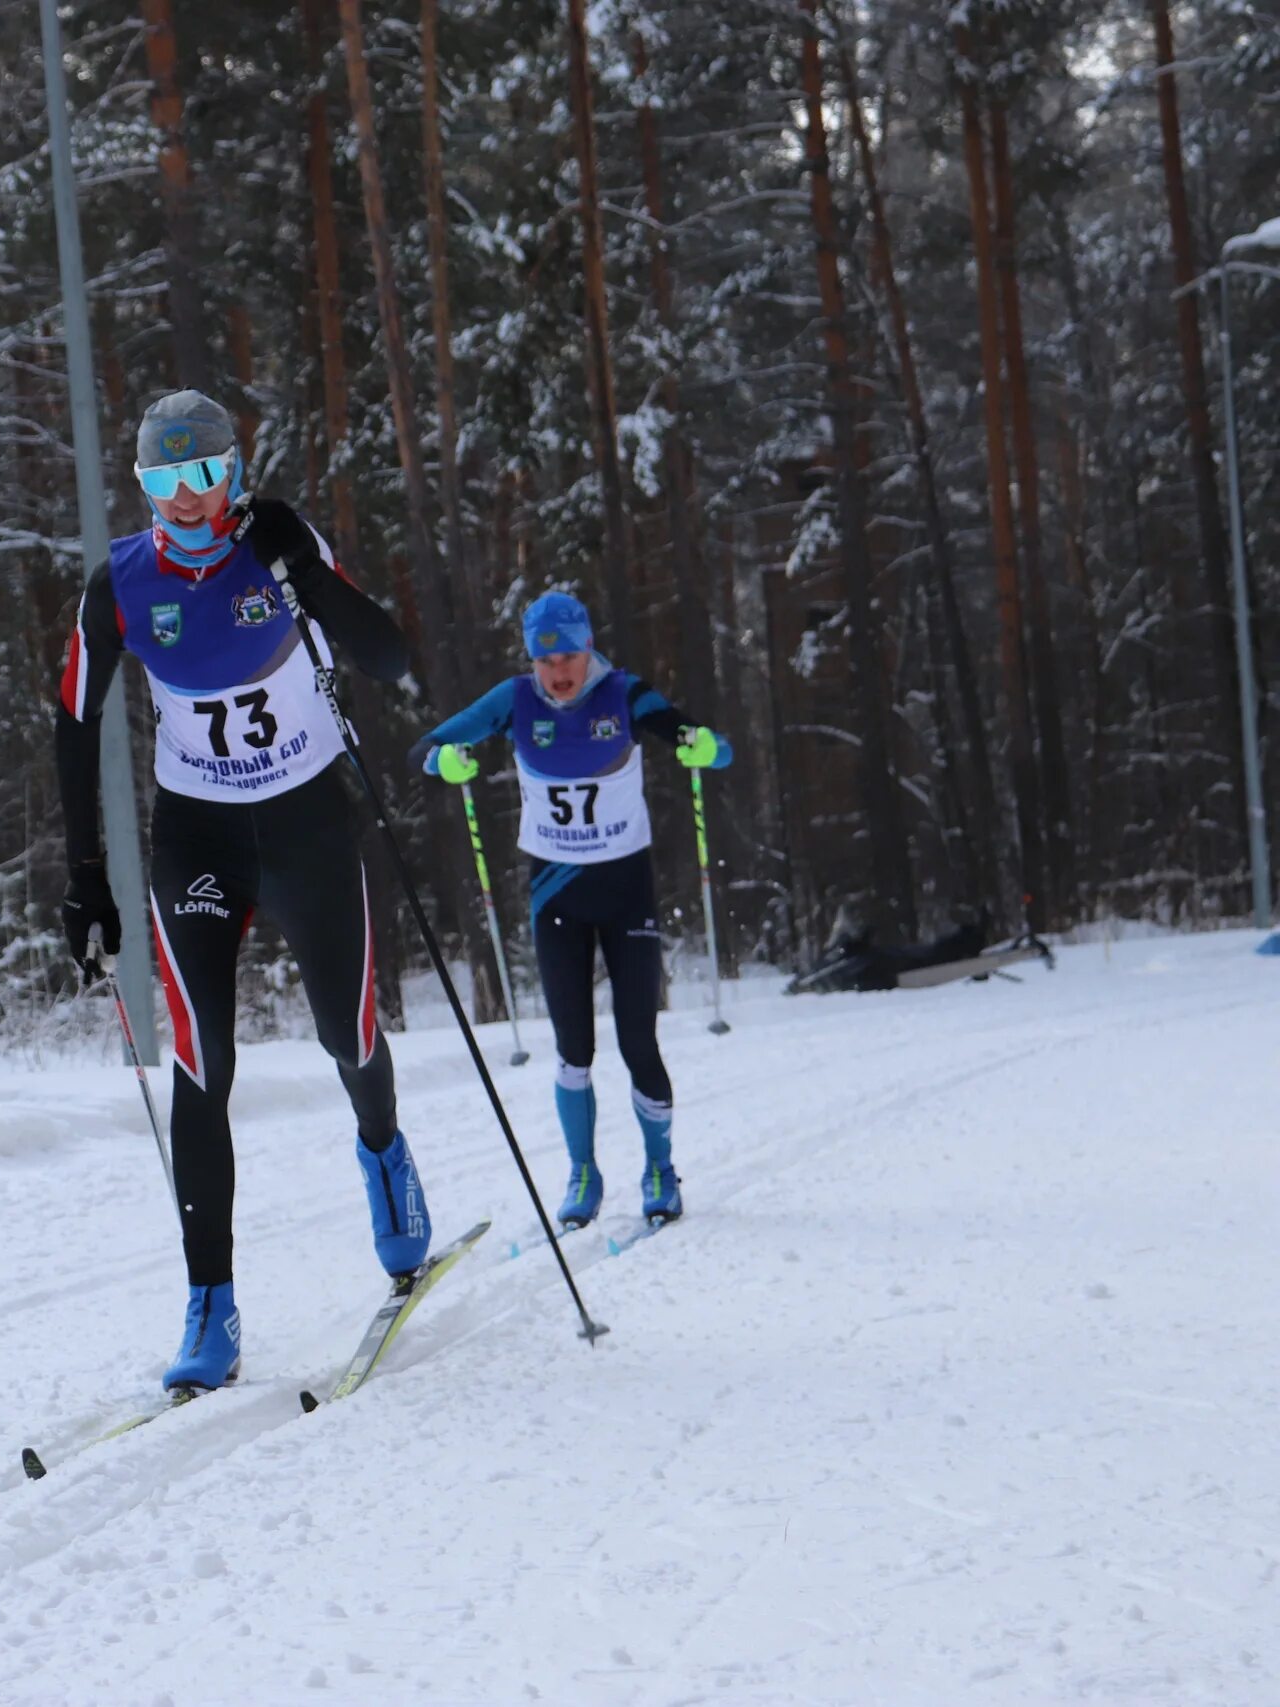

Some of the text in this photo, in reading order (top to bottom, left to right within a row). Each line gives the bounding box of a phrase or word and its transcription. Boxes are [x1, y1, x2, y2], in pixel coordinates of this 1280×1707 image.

[193, 687, 278, 757] 73
[279, 729, 309, 761] БОР
[547, 783, 599, 826] 57
[174, 901, 231, 919] Löffler
[404, 1150, 425, 1239] SPIN
